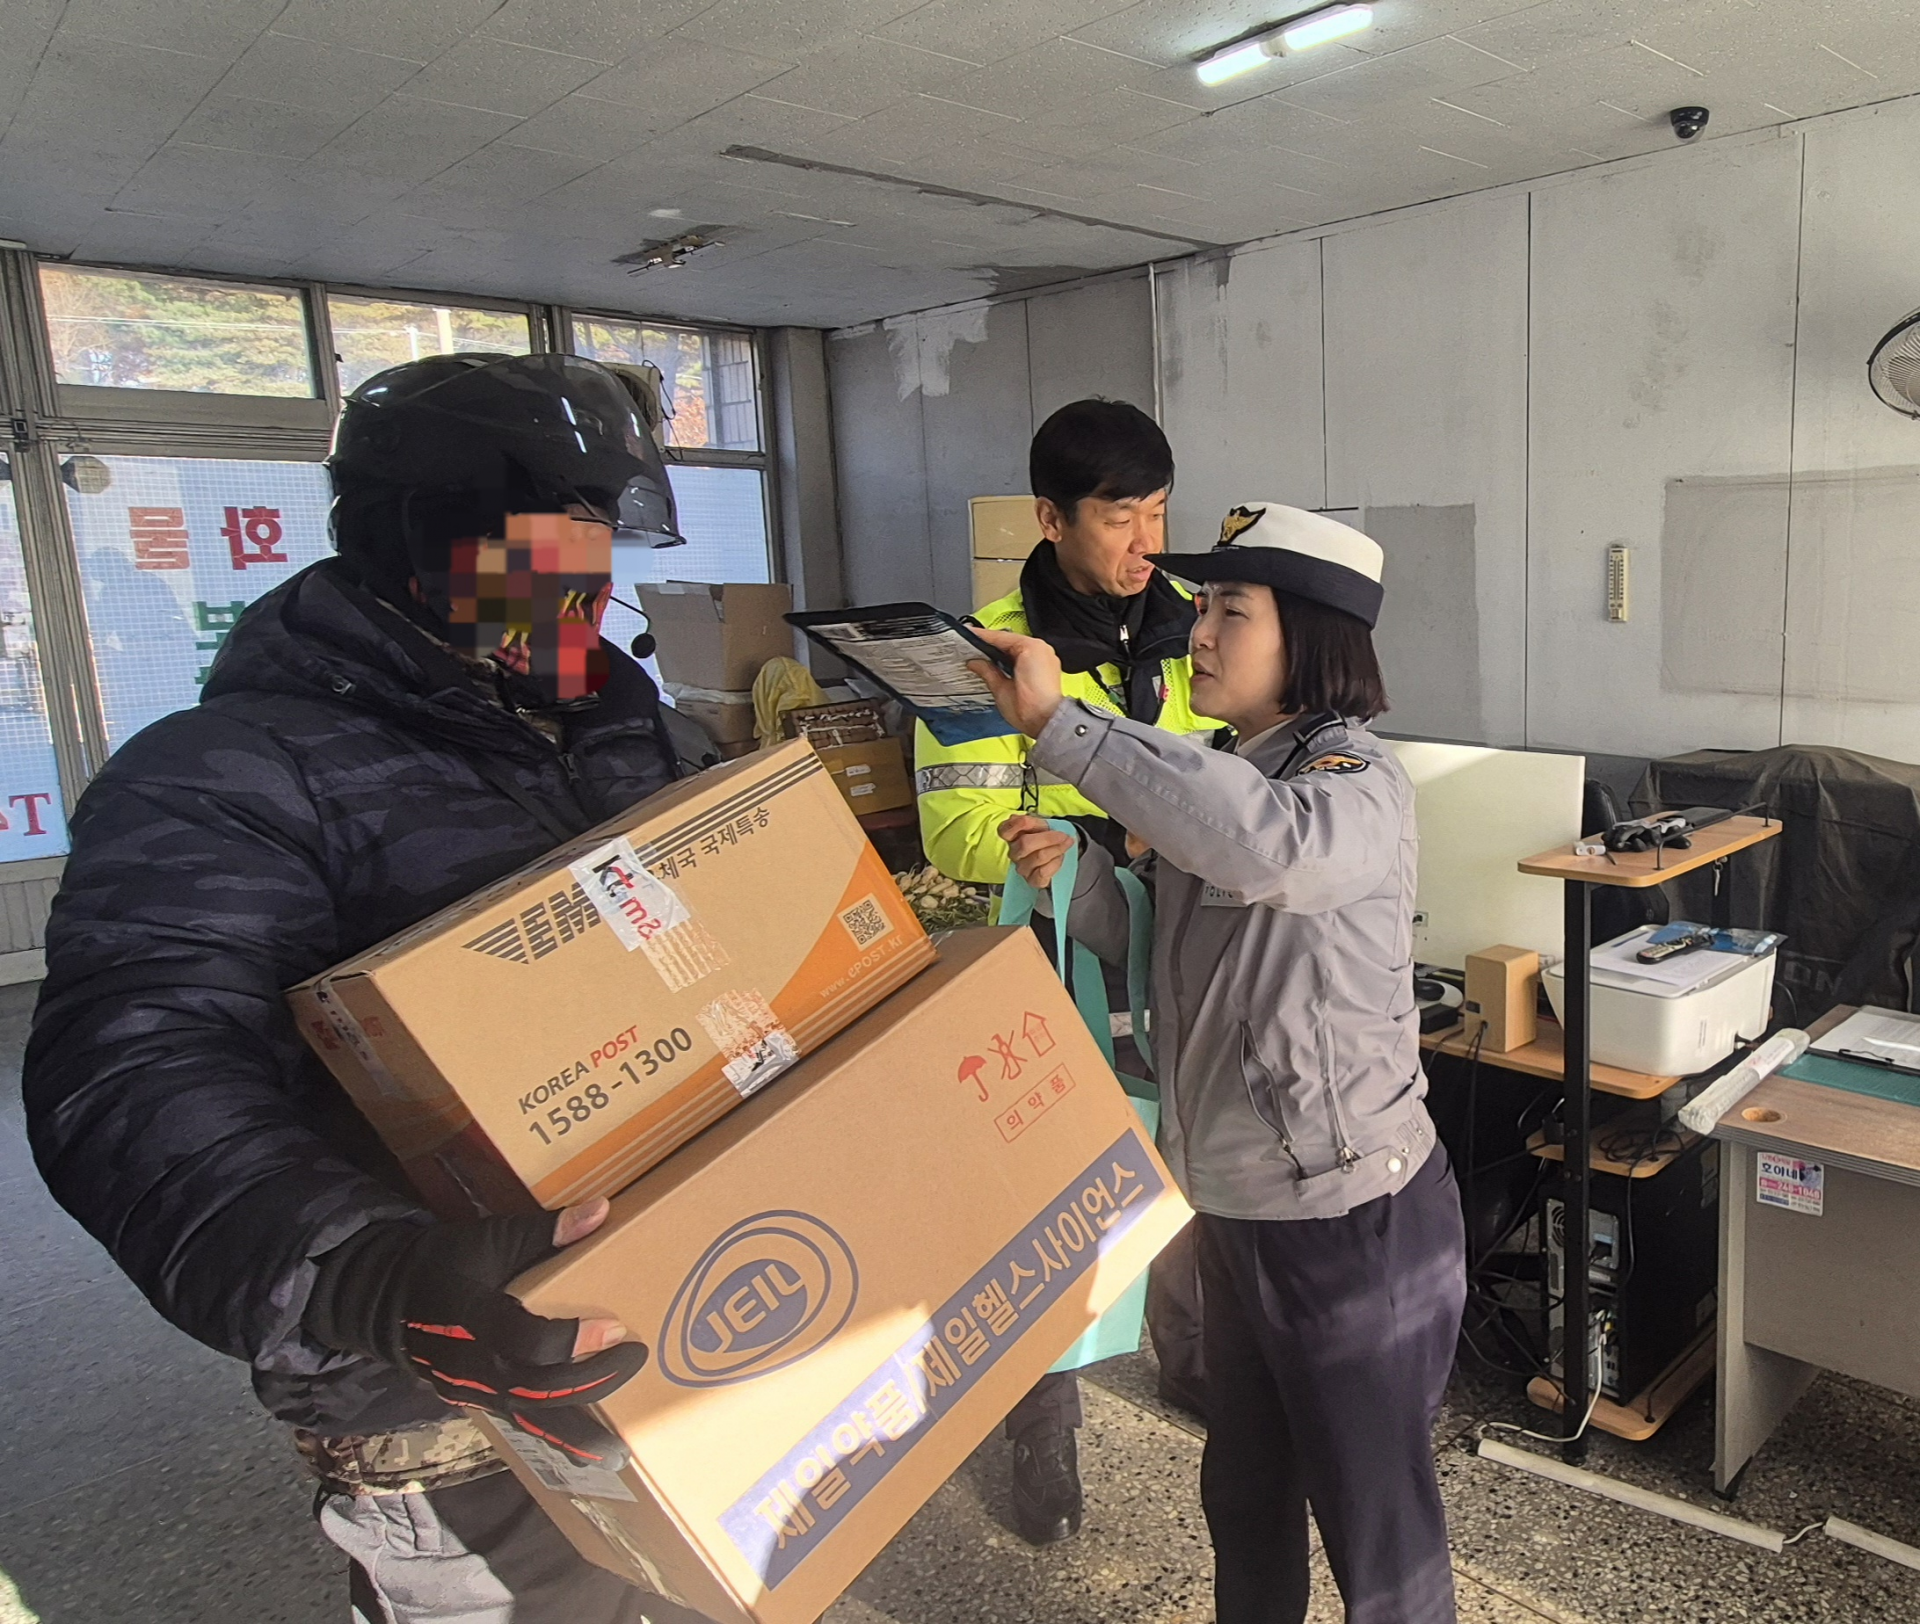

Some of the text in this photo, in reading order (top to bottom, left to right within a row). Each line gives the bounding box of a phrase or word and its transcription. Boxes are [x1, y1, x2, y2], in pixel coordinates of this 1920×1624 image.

[648, 806, 770, 881] 체국 국제특송
[518, 1025, 640, 1115] KOREA POST
[529, 1027, 692, 1146] 1588-1300
[705, 1263, 806, 1354] JEIL
